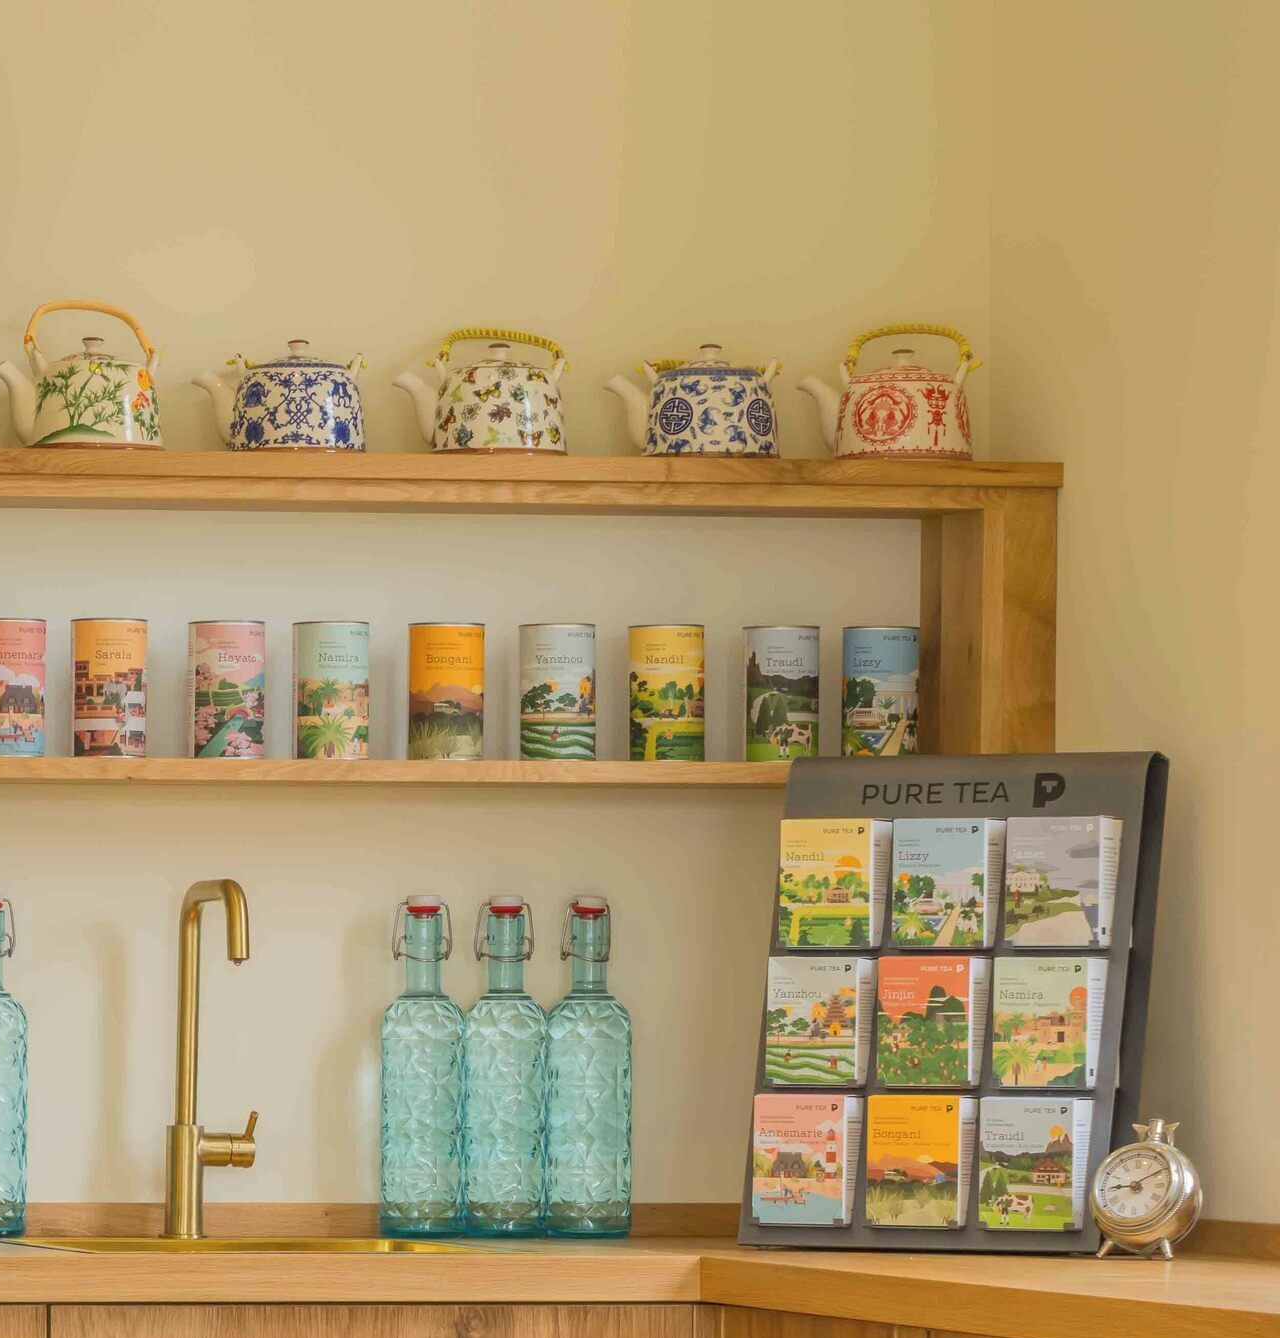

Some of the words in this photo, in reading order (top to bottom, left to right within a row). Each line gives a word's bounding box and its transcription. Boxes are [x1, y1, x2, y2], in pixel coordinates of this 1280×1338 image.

[95, 650, 132, 660] Sarala
[218, 653, 256, 664] Hayato
[318, 653, 359, 662] Namira
[426, 654, 471, 665] Bongani
[535, 655, 583, 664] Yanzhou
[645, 655, 684, 664] Nandil
[765, 658, 803, 667] Traudl
[853, 657, 882, 668] Lizzy
[861, 783, 944, 805] PURE
[953, 782, 1010, 804] TEA
[786, 852, 824, 861] Nandil
[898, 851, 929, 862] Lizzy
[773, 989, 821, 999] Yanzhou
[882, 989, 914, 1000] Jinjin
[999, 990, 1044, 999] Namira
[758, 1128, 823, 1137] Annemarie
[872, 1128, 921, 1141] Bongani
[984, 1131, 1024, 1141] Traudl
